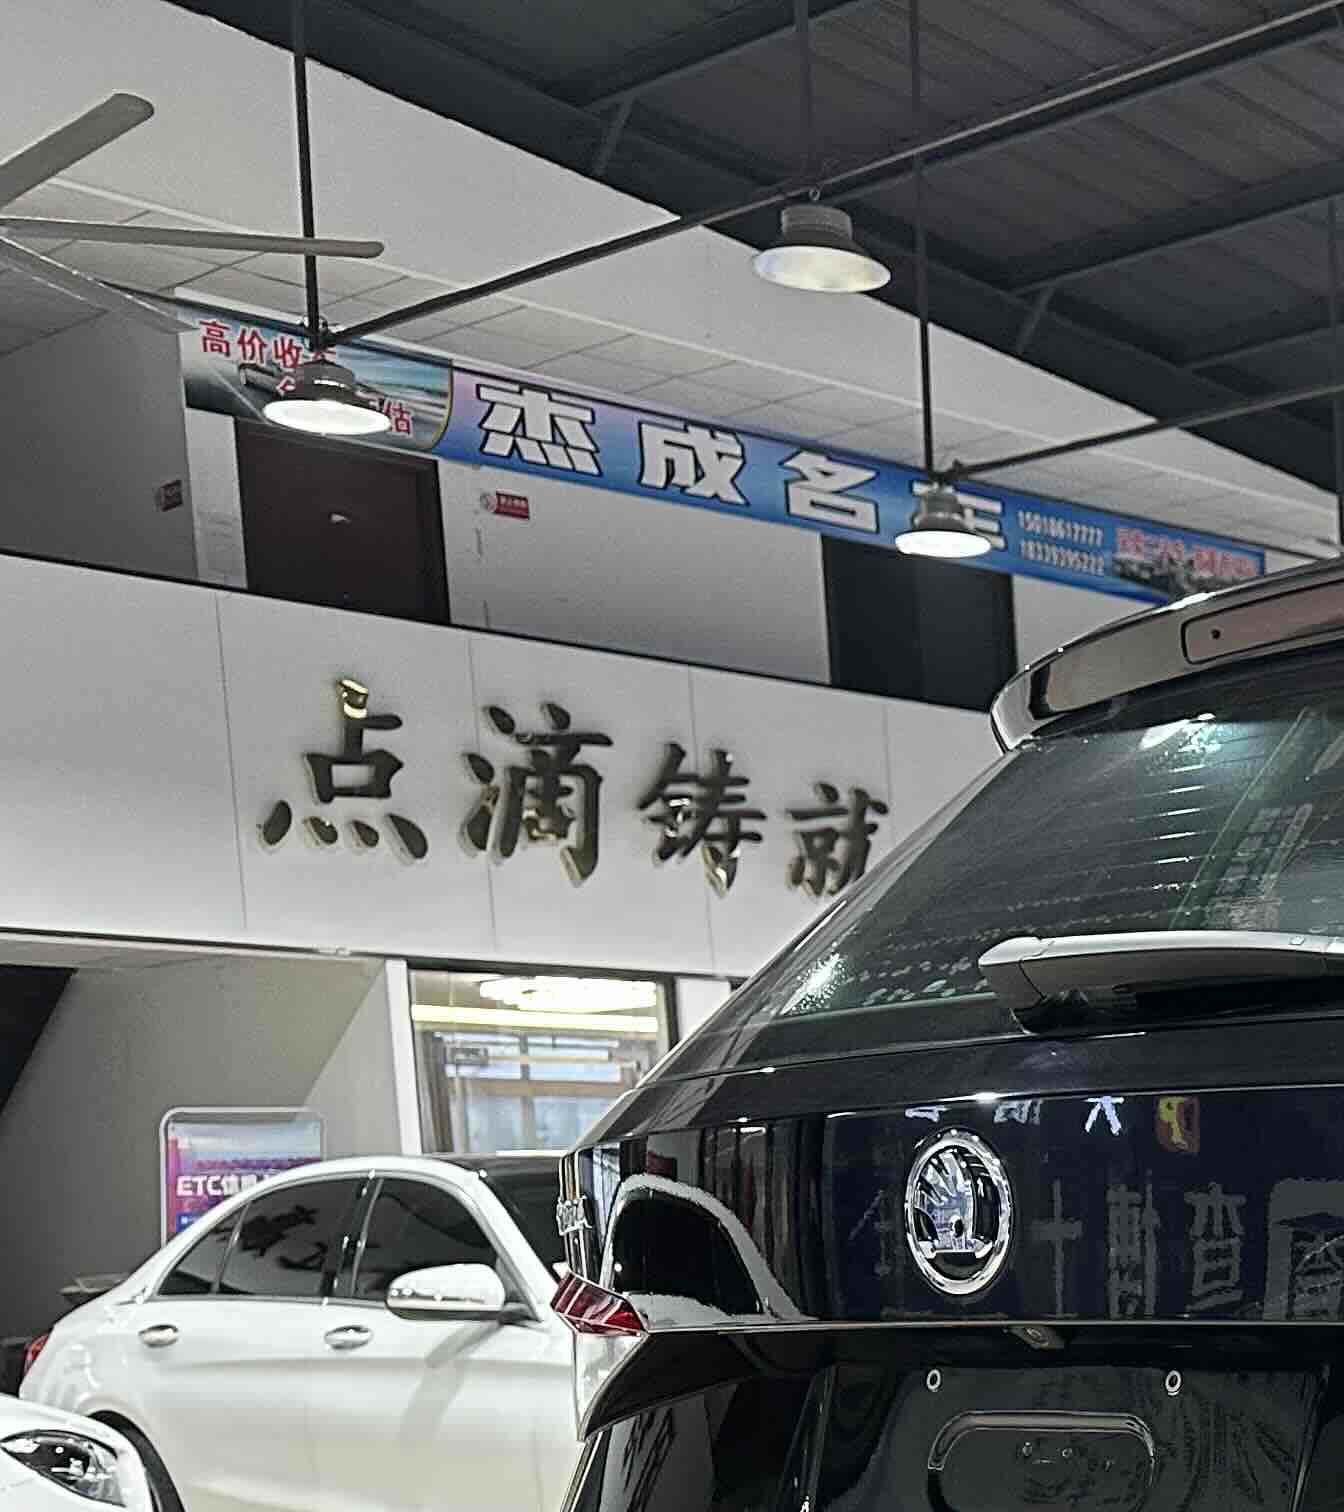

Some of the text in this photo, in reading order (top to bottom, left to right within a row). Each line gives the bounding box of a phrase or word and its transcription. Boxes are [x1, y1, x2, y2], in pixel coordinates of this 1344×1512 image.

[198, 319, 338, 373] 高价收
[256, 678, 890, 899] 点滴铸就
